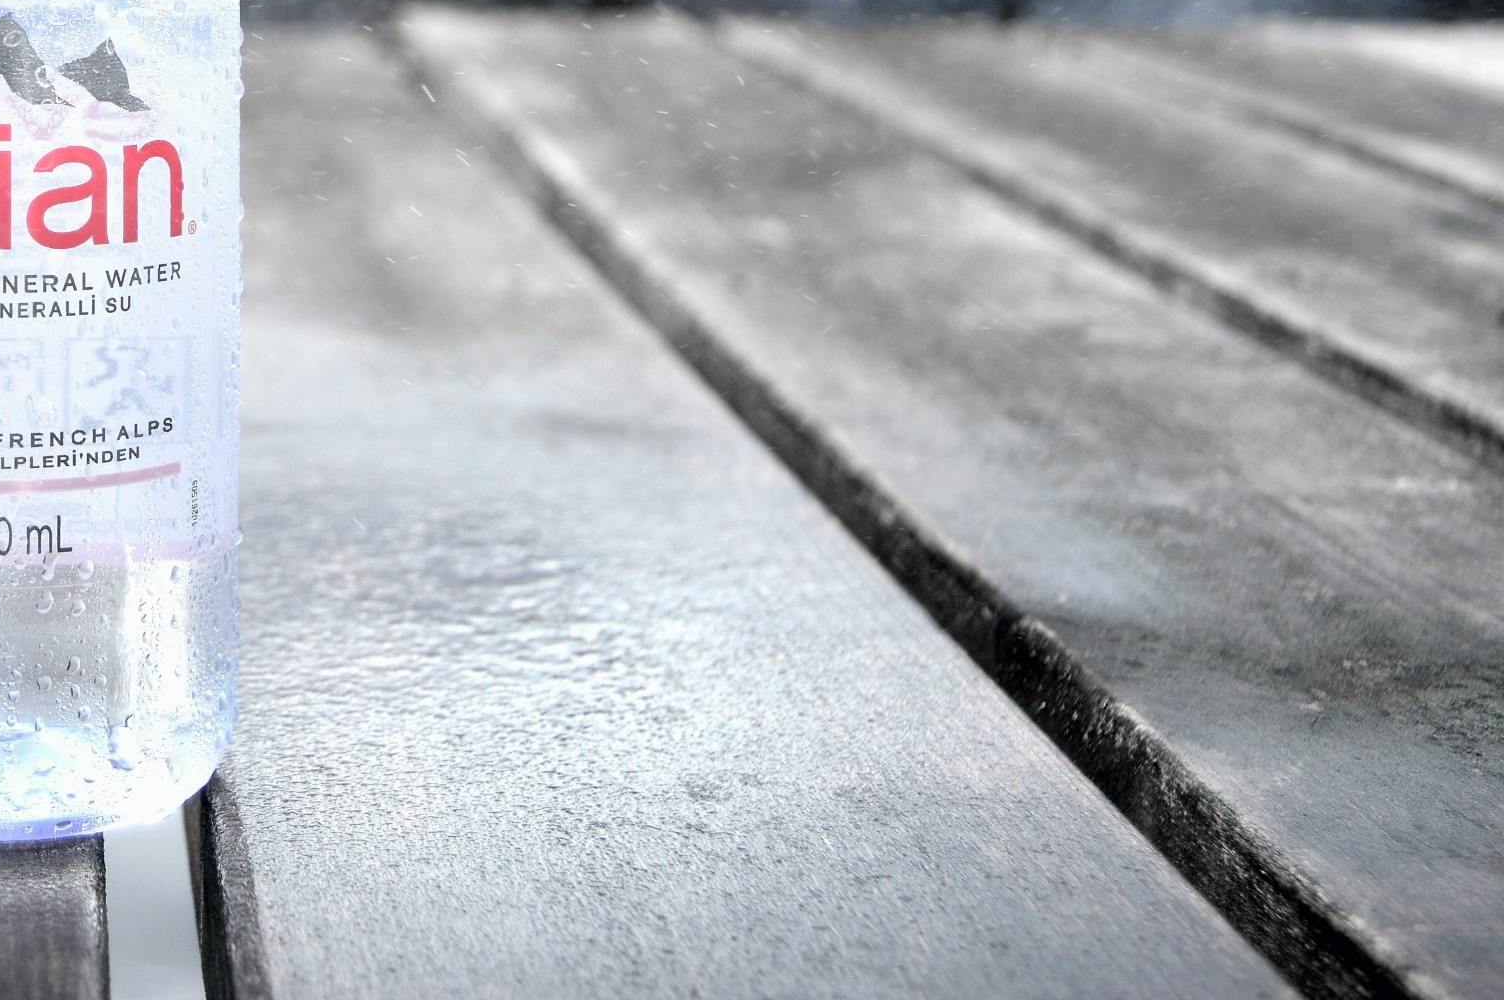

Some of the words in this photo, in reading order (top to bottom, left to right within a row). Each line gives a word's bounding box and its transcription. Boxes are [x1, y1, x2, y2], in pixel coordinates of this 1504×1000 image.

[105, 261, 181, 288] WATER
[105, 295, 131, 313] SU
[117, 417, 173, 440] ALPS
[27, 514, 73, 555] mL
